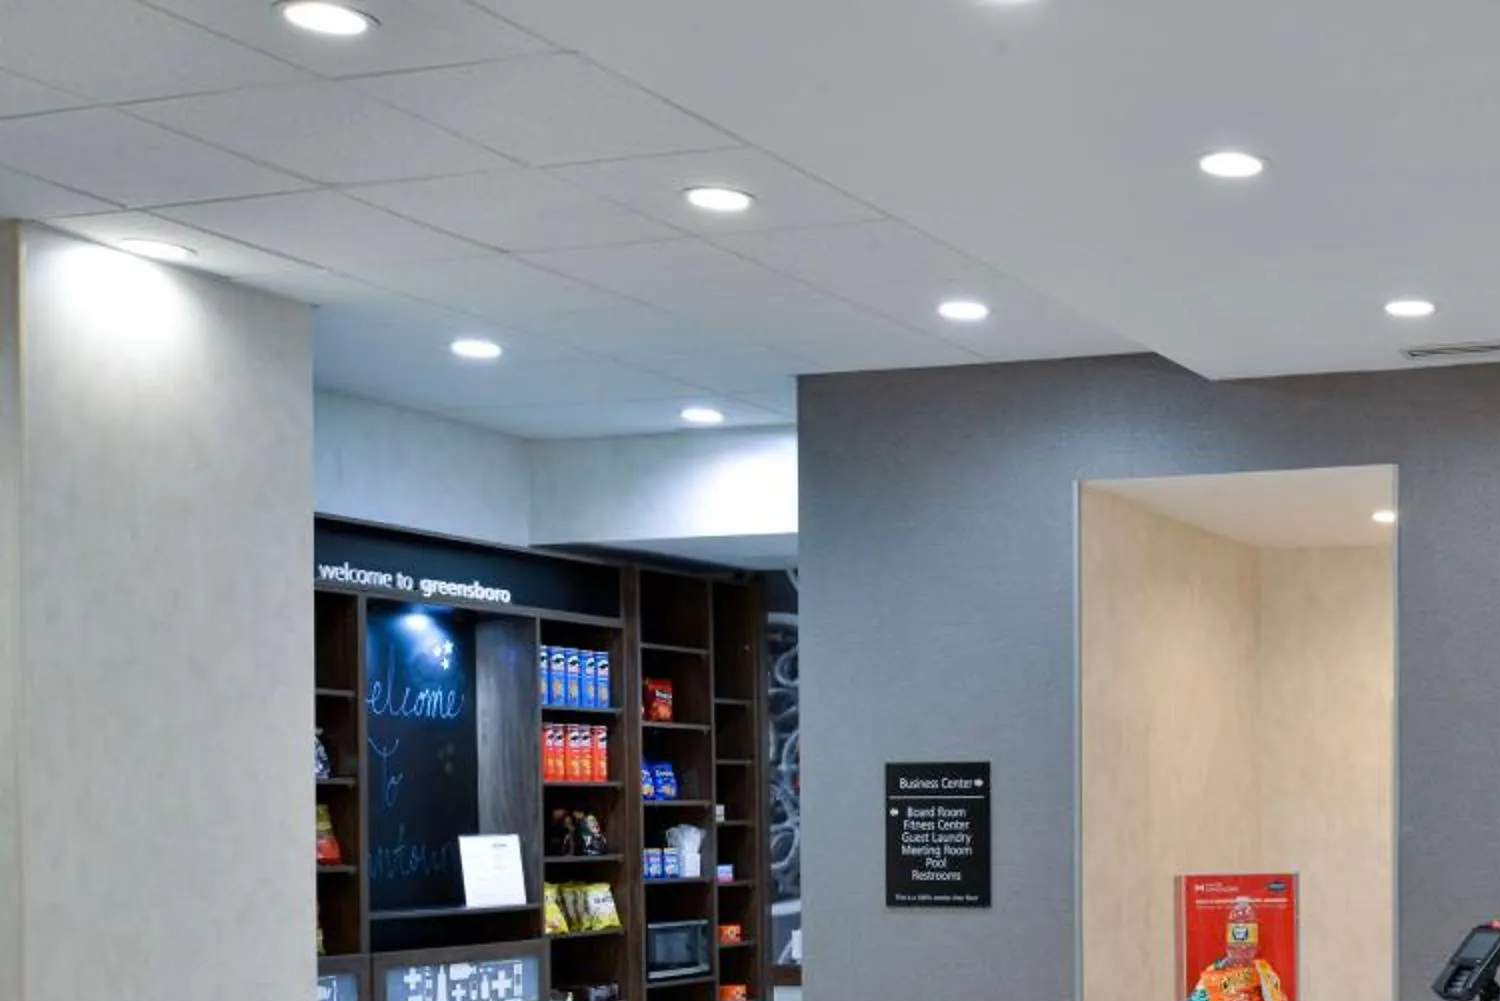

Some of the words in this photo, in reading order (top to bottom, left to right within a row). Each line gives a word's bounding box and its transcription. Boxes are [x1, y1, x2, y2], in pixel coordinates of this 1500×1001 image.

[318, 562, 392, 587] welcome
[395, 572, 413, 591] to
[419, 578, 511, 603] greensboro
[366, 644, 465, 718] elcome
[899, 777, 939, 789] Business
[941, 777, 973, 789] Center
[907, 806, 935, 818] Board
[937, 806, 966, 818] Room
[903, 820, 935, 831] Fitness
[937, 820, 970, 831] Center
[901, 832, 929, 843] Guest
[931, 832, 972, 845] Laundry
[901, 845, 941, 858] Meeting
[943, 845, 972, 856] Room
[925, 857, 947, 868] Pool
[911, 870, 962, 881] Restrooms
